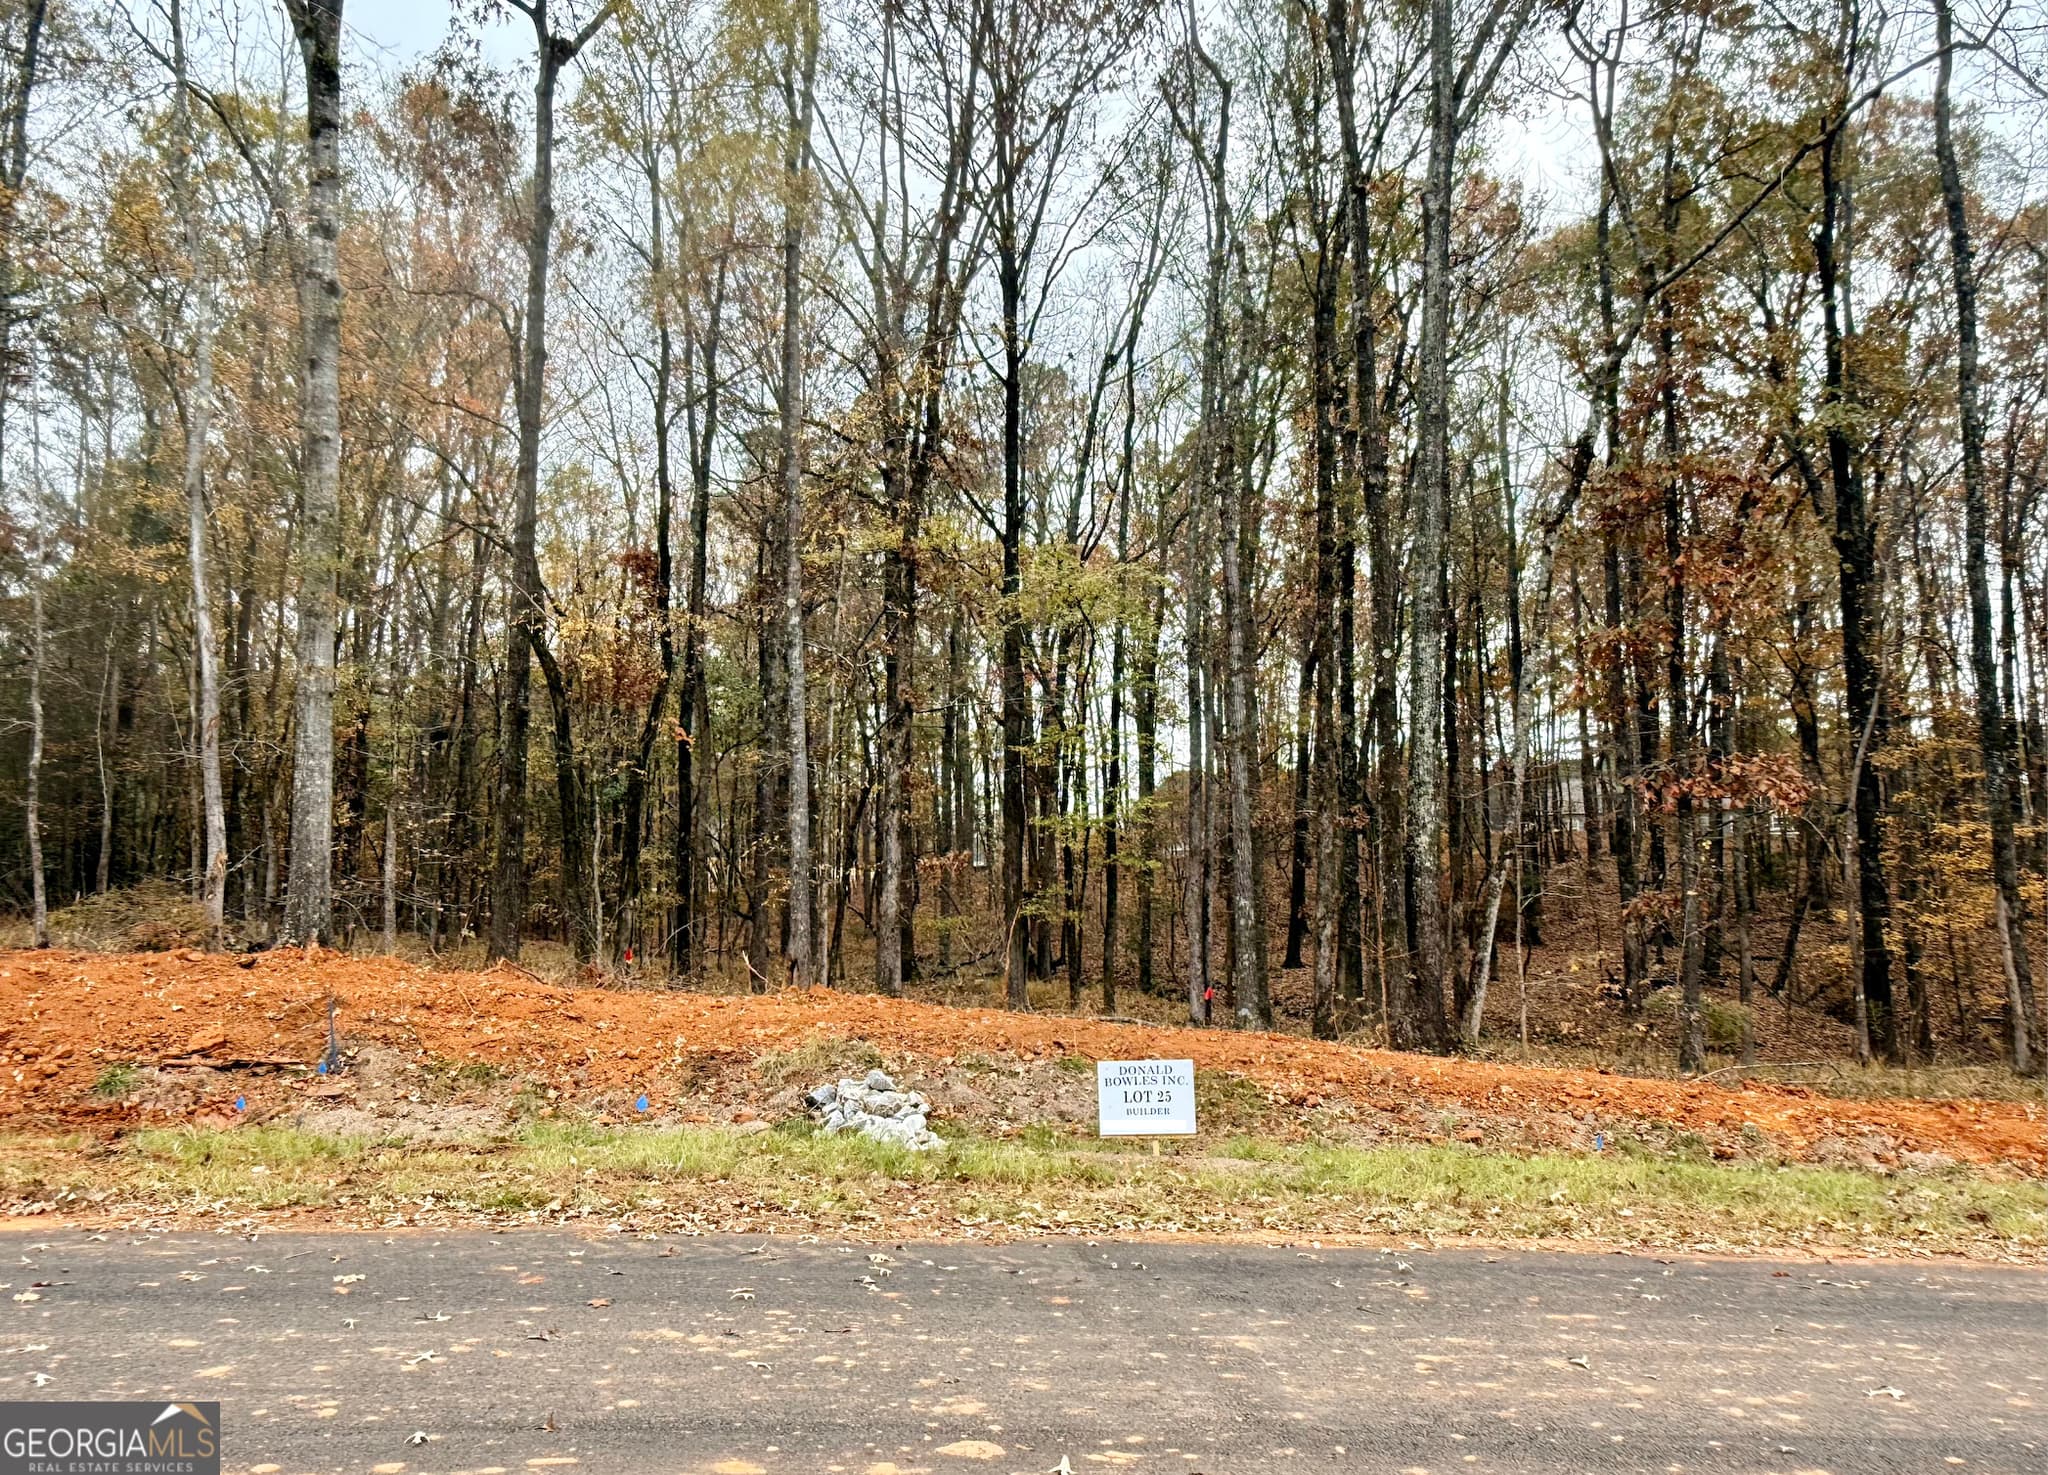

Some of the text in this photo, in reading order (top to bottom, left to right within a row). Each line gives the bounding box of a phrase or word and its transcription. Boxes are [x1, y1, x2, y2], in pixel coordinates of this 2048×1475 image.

[1119, 1065, 1173, 1075] DONALD
[1105, 1075, 1189, 1087] BOWLES INC.
[1124, 1090, 1172, 1103] LOT 25
[1126, 1107, 1170, 1116] BUILDER
